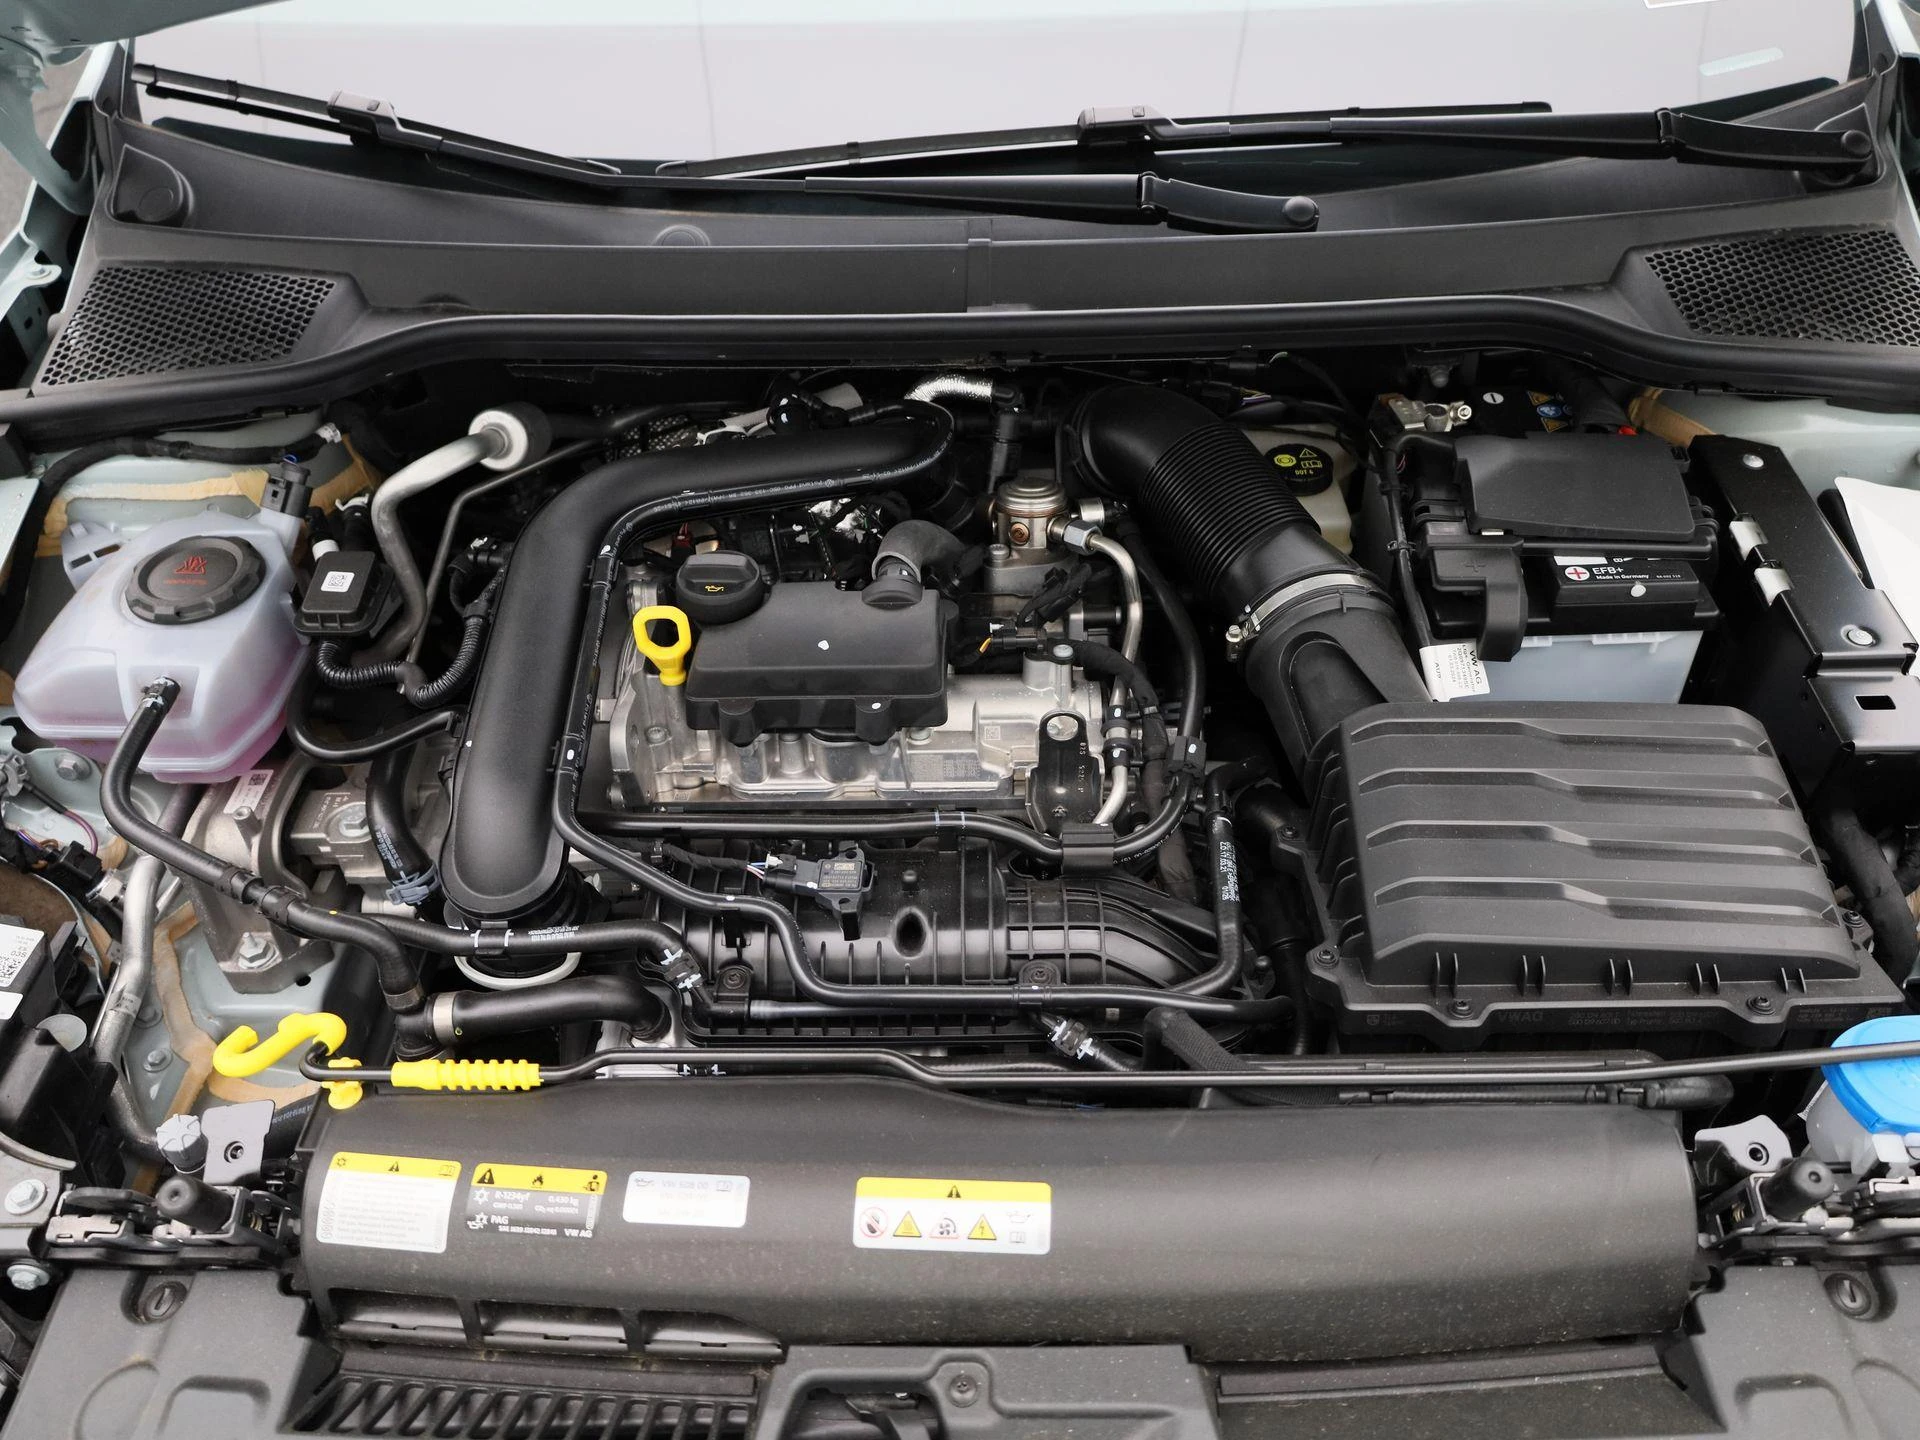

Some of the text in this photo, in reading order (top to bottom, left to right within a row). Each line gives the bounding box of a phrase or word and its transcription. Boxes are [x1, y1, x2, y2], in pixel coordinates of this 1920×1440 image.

[1592, 566, 1624, 575] EFB+
[1469, 649, 1483, 685] VW AG
[570, 1196, 579, 1206] kg
[490, 1215, 509, 1225] PAG
[564, 1228, 593, 1238] VW AG
